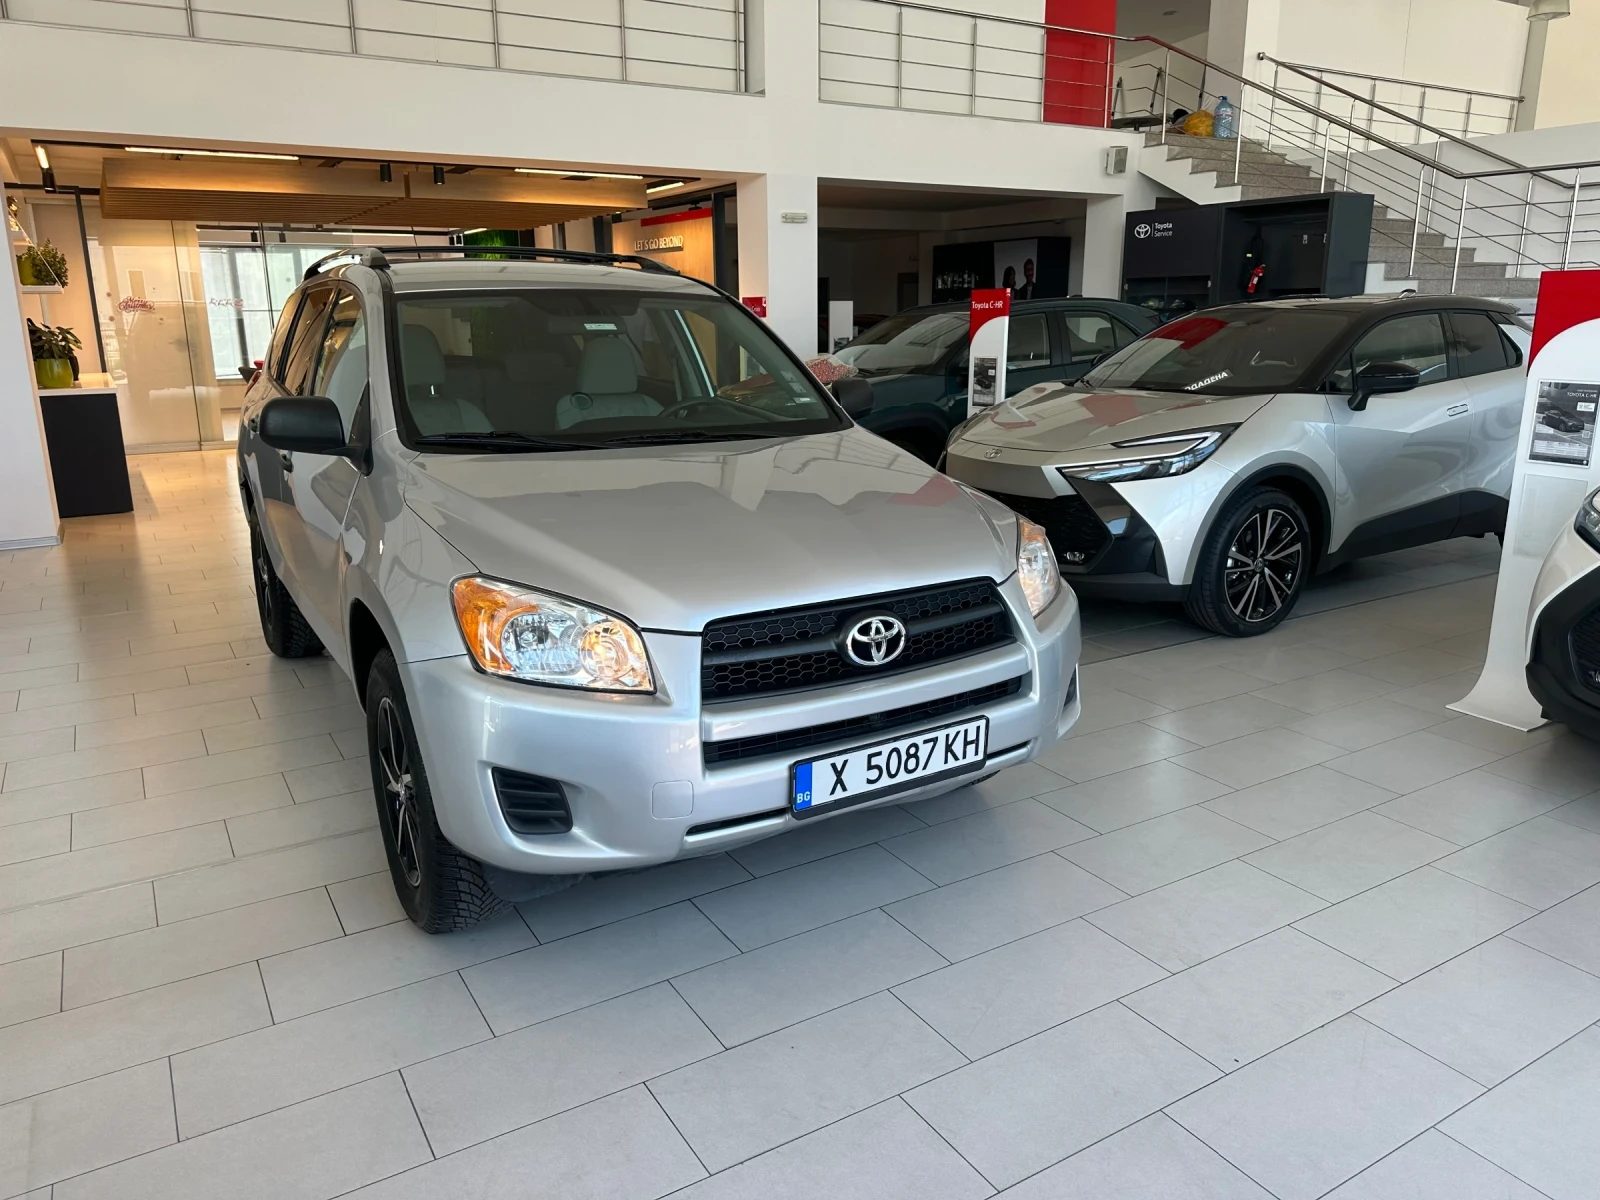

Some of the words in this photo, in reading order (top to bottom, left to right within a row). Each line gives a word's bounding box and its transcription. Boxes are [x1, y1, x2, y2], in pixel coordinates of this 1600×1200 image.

[1154, 222, 1173, 231] Toyota
[1154, 230, 1173, 238] Service
[649, 238, 659, 250] GO
[658, 235, 684, 249] BEYOND
[971, 301, 989, 311] Toyota
[989, 300, 1004, 309] C-HR
[829, 758, 849, 796] X
[865, 736, 939, 785] 5087
[943, 725, 981, 765] KH
[796, 791, 811, 803] BG
